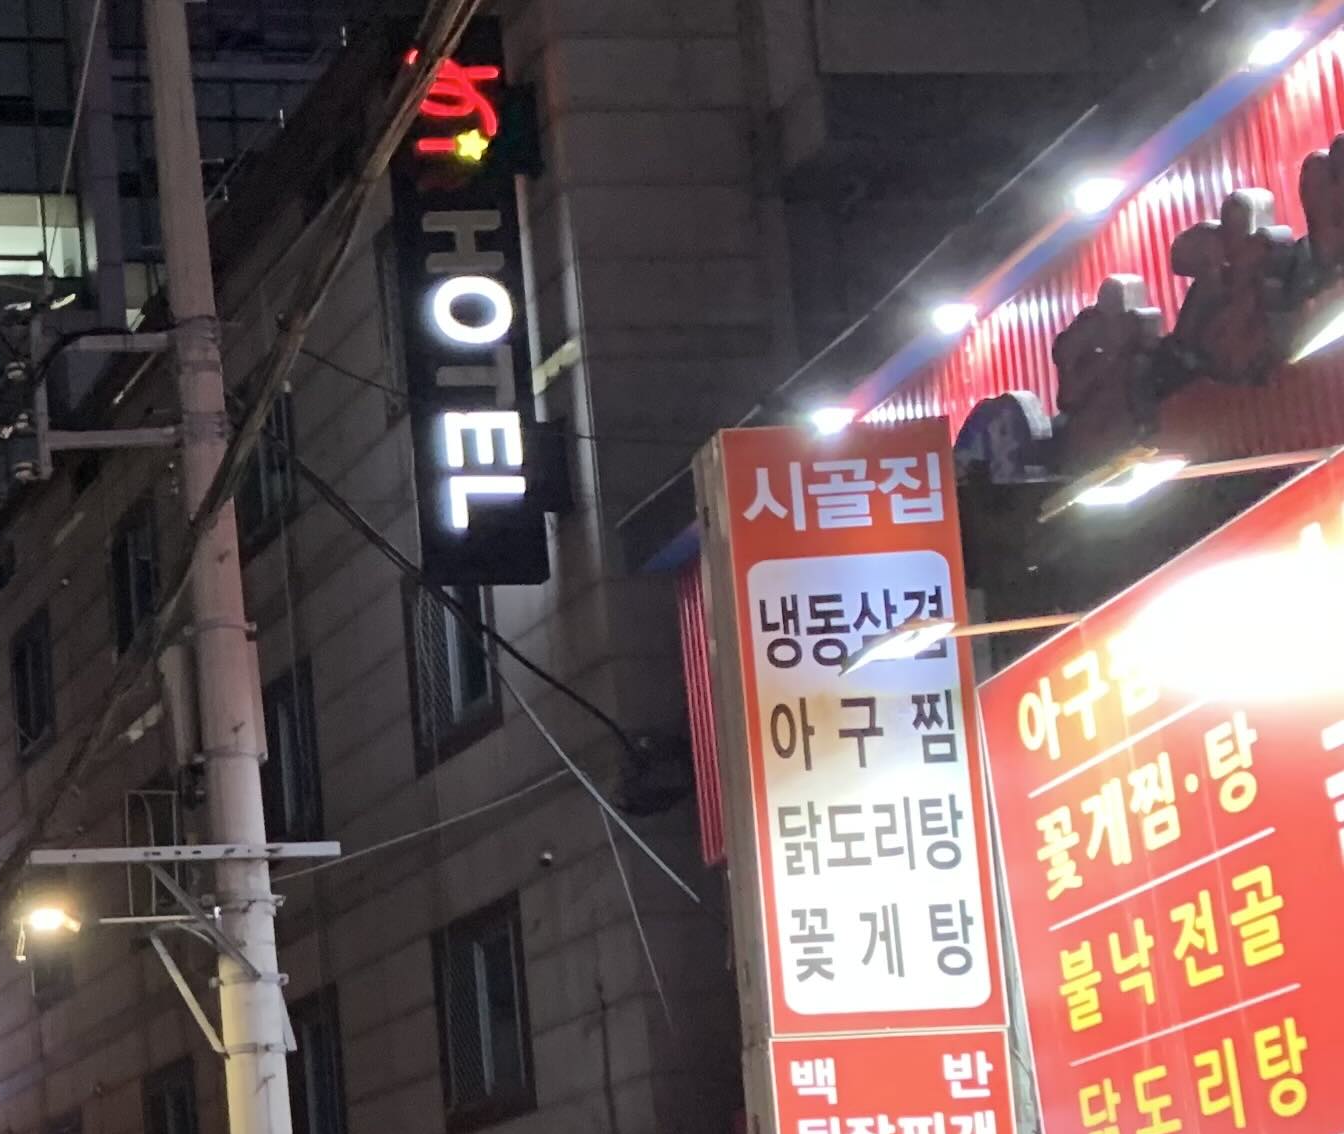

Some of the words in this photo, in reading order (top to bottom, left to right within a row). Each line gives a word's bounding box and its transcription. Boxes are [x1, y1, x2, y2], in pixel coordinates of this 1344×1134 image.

[421, 208, 527, 531] HOTEL
[743, 451, 946, 532] 시골집
[769, 689, 960, 772] 아구찜
[777, 794, 964, 876] 닭도리탕
[789, 899, 975, 983] 꽃게탕
[1058, 863, 1285, 1032] 불낙전골
